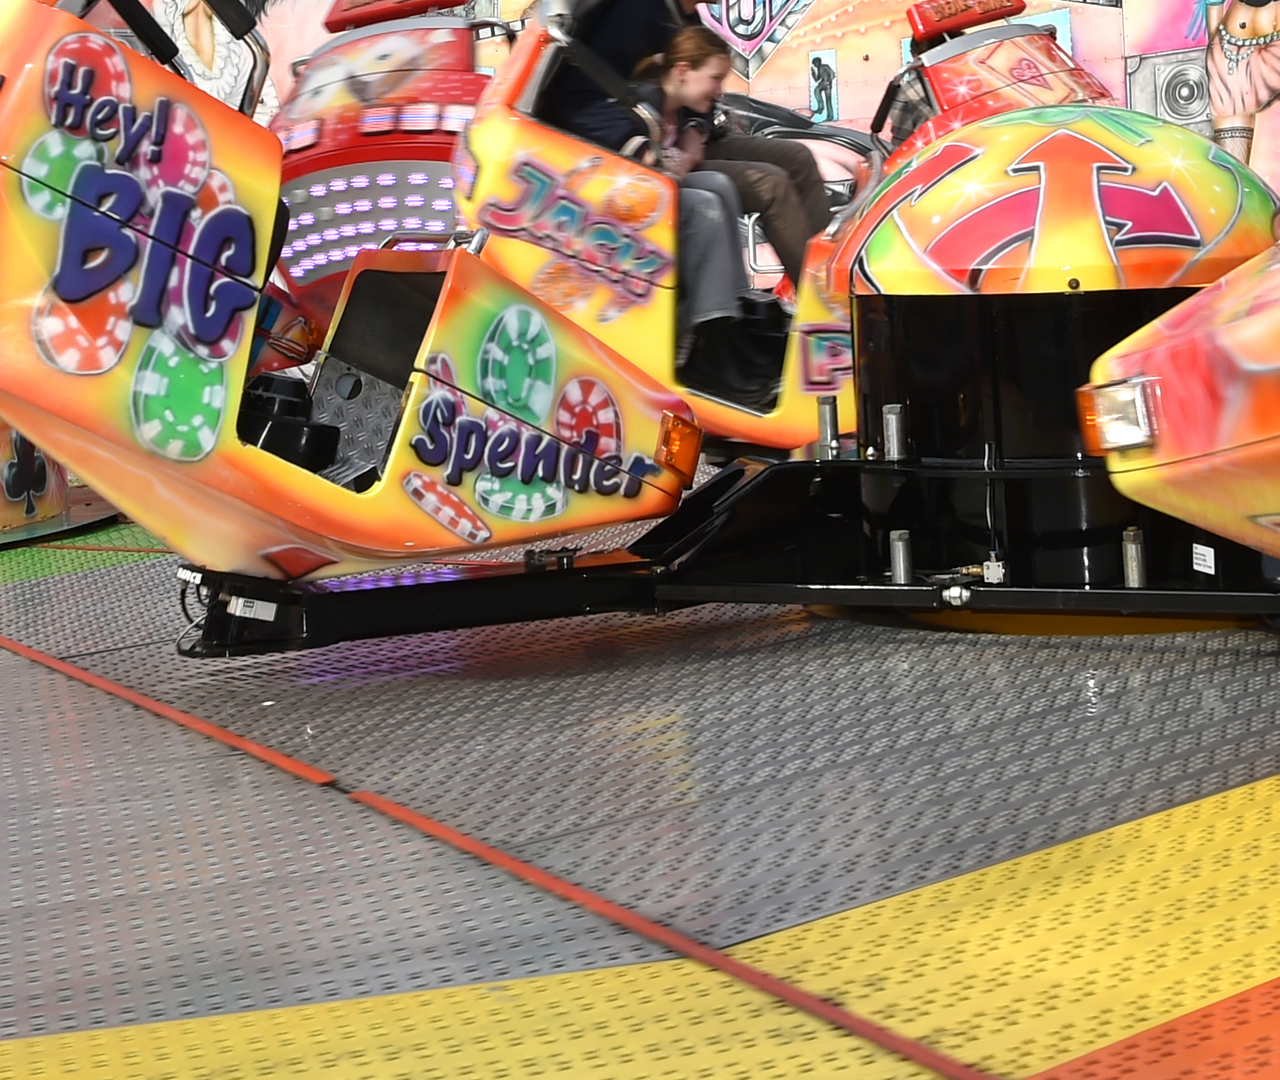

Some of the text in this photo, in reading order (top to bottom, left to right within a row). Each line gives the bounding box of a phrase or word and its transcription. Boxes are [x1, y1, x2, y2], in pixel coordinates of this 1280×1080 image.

[47, 58, 169, 165] Hey!
[53, 160, 261, 345] BIG
[480, 157, 676, 306] JACK
[410, 391, 663, 498] Spender
